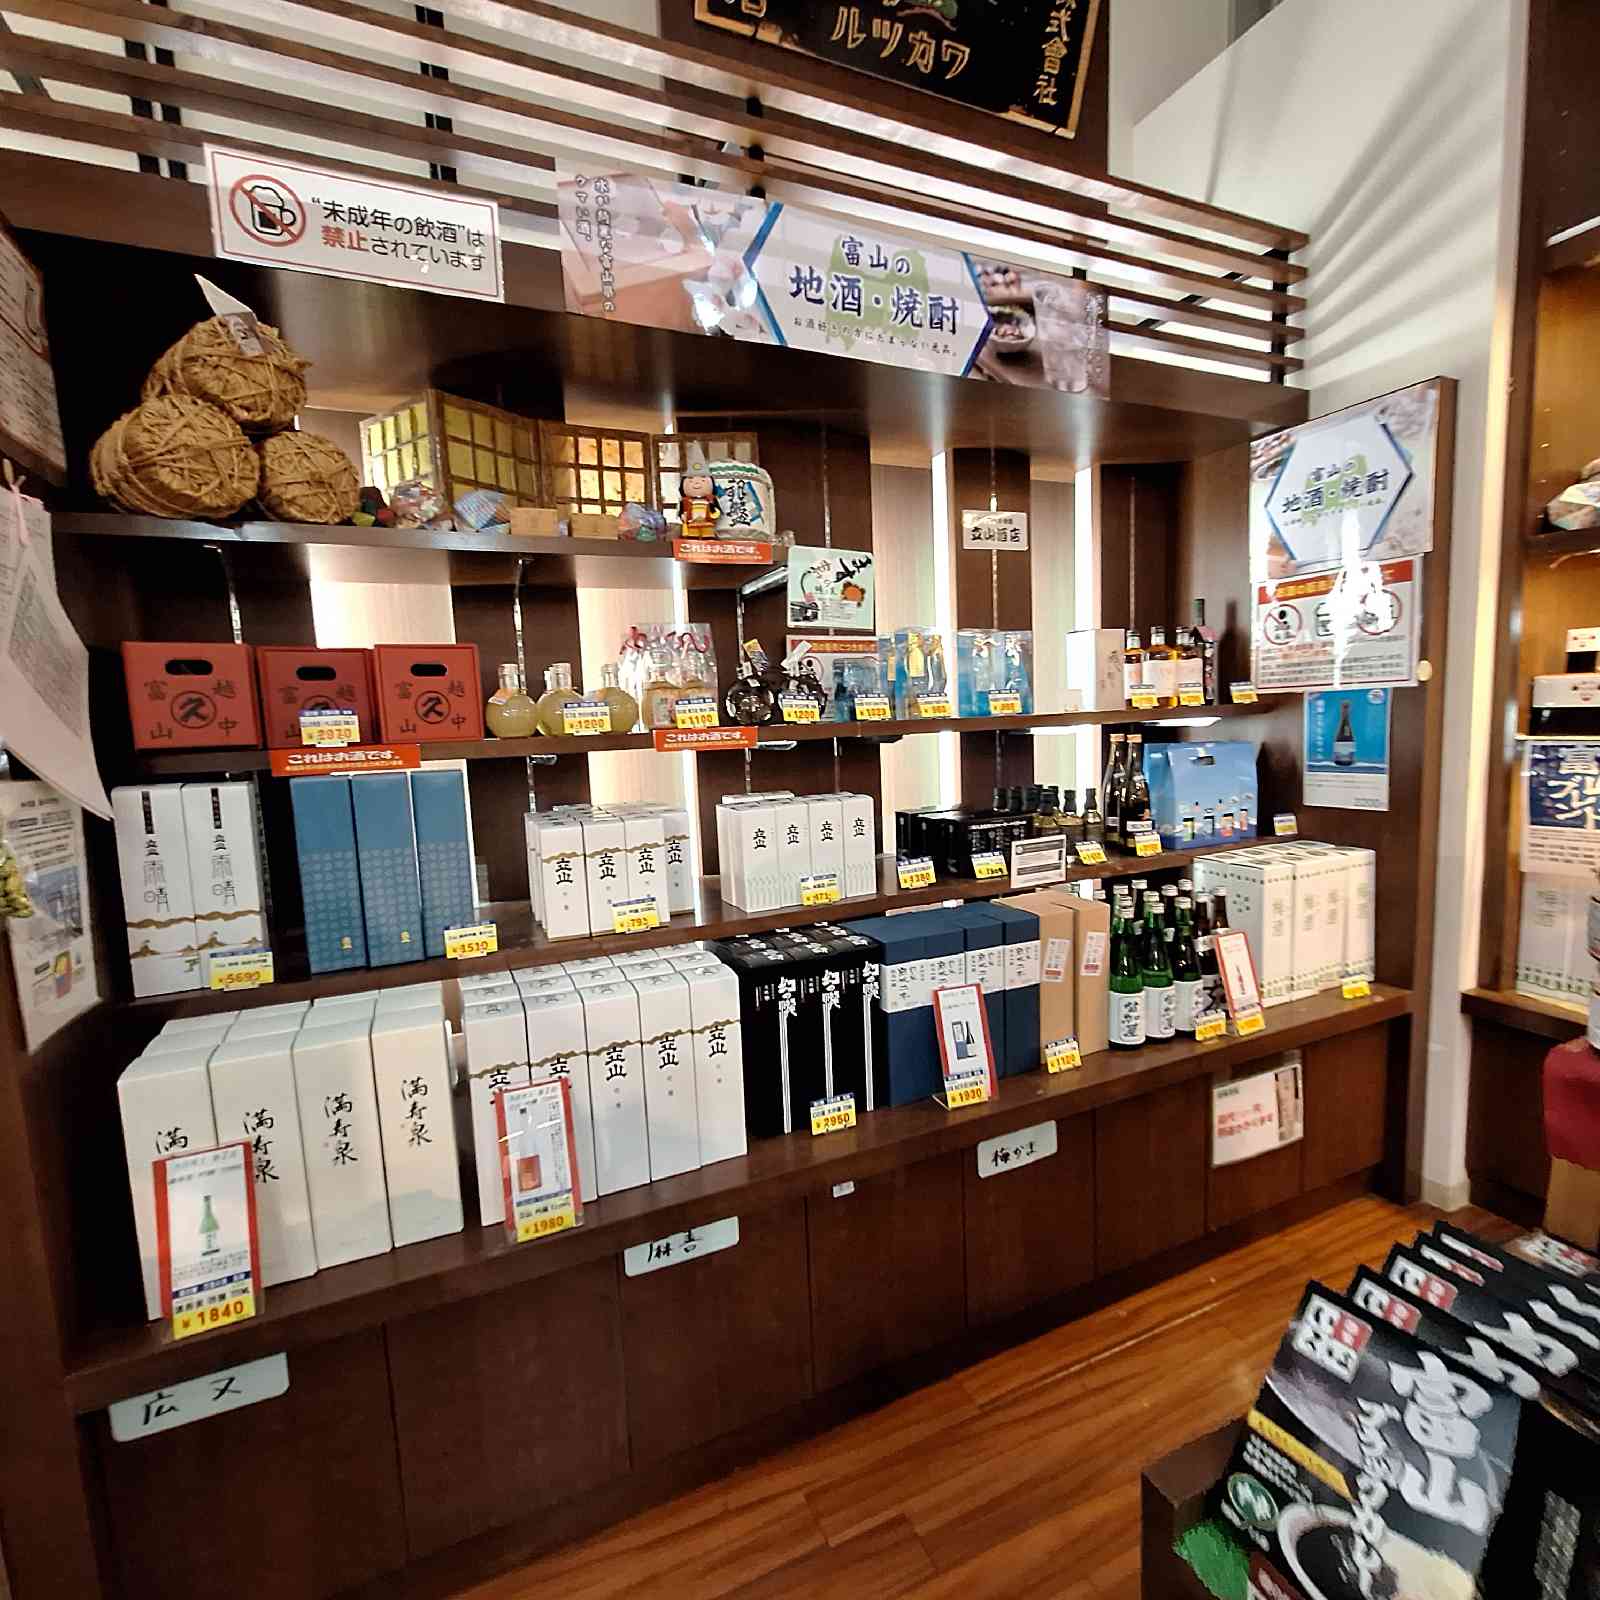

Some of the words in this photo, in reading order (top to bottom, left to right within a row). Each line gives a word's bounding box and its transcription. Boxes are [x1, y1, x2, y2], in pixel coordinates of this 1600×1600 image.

[322, 225, 487, 273] 禁止されています
[841, 235, 911, 276] 富山の
[789, 265, 961, 336] 地酒・焼酎
[753, 828, 768, 850] 立山
[787, 824, 800, 845] 立山
[820, 820, 834, 842] 立山
[852, 817, 865, 837] 立山
[638, 848, 656, 875] 立山
[667, 839, 683, 865] 立山
[555, 858, 574, 885] 立山
[598, 853, 617, 880] 立山
[658, 1035, 680, 1070] 立山
[708, 1025, 728, 1058] 立山
[604, 1046, 628, 1082] 立山
